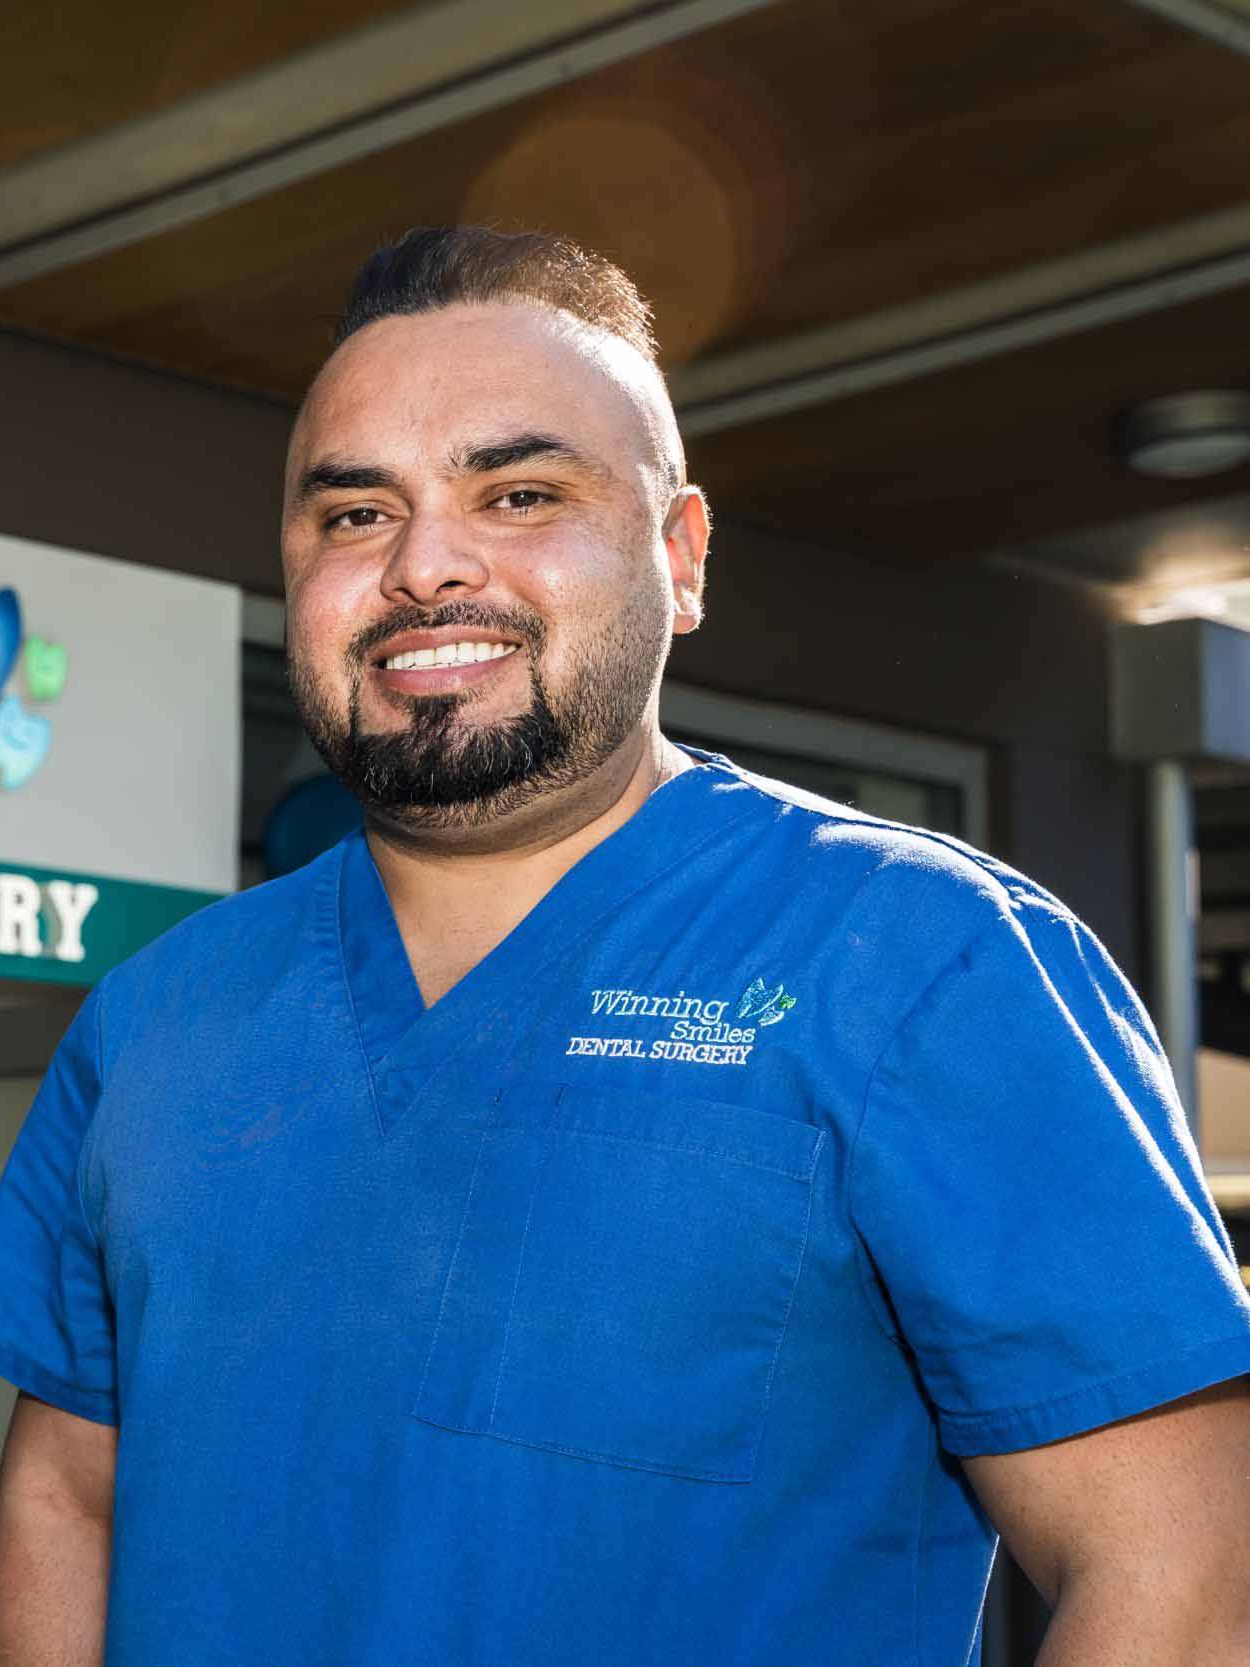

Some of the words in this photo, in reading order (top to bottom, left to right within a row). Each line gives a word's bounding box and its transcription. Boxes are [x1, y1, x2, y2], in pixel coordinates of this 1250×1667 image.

[591, 989, 729, 1025] Winning
[670, 1020, 756, 1043] Smiles
[566, 1036, 646, 1058] DENTAL
[649, 1040, 753, 1065] SURGERY
